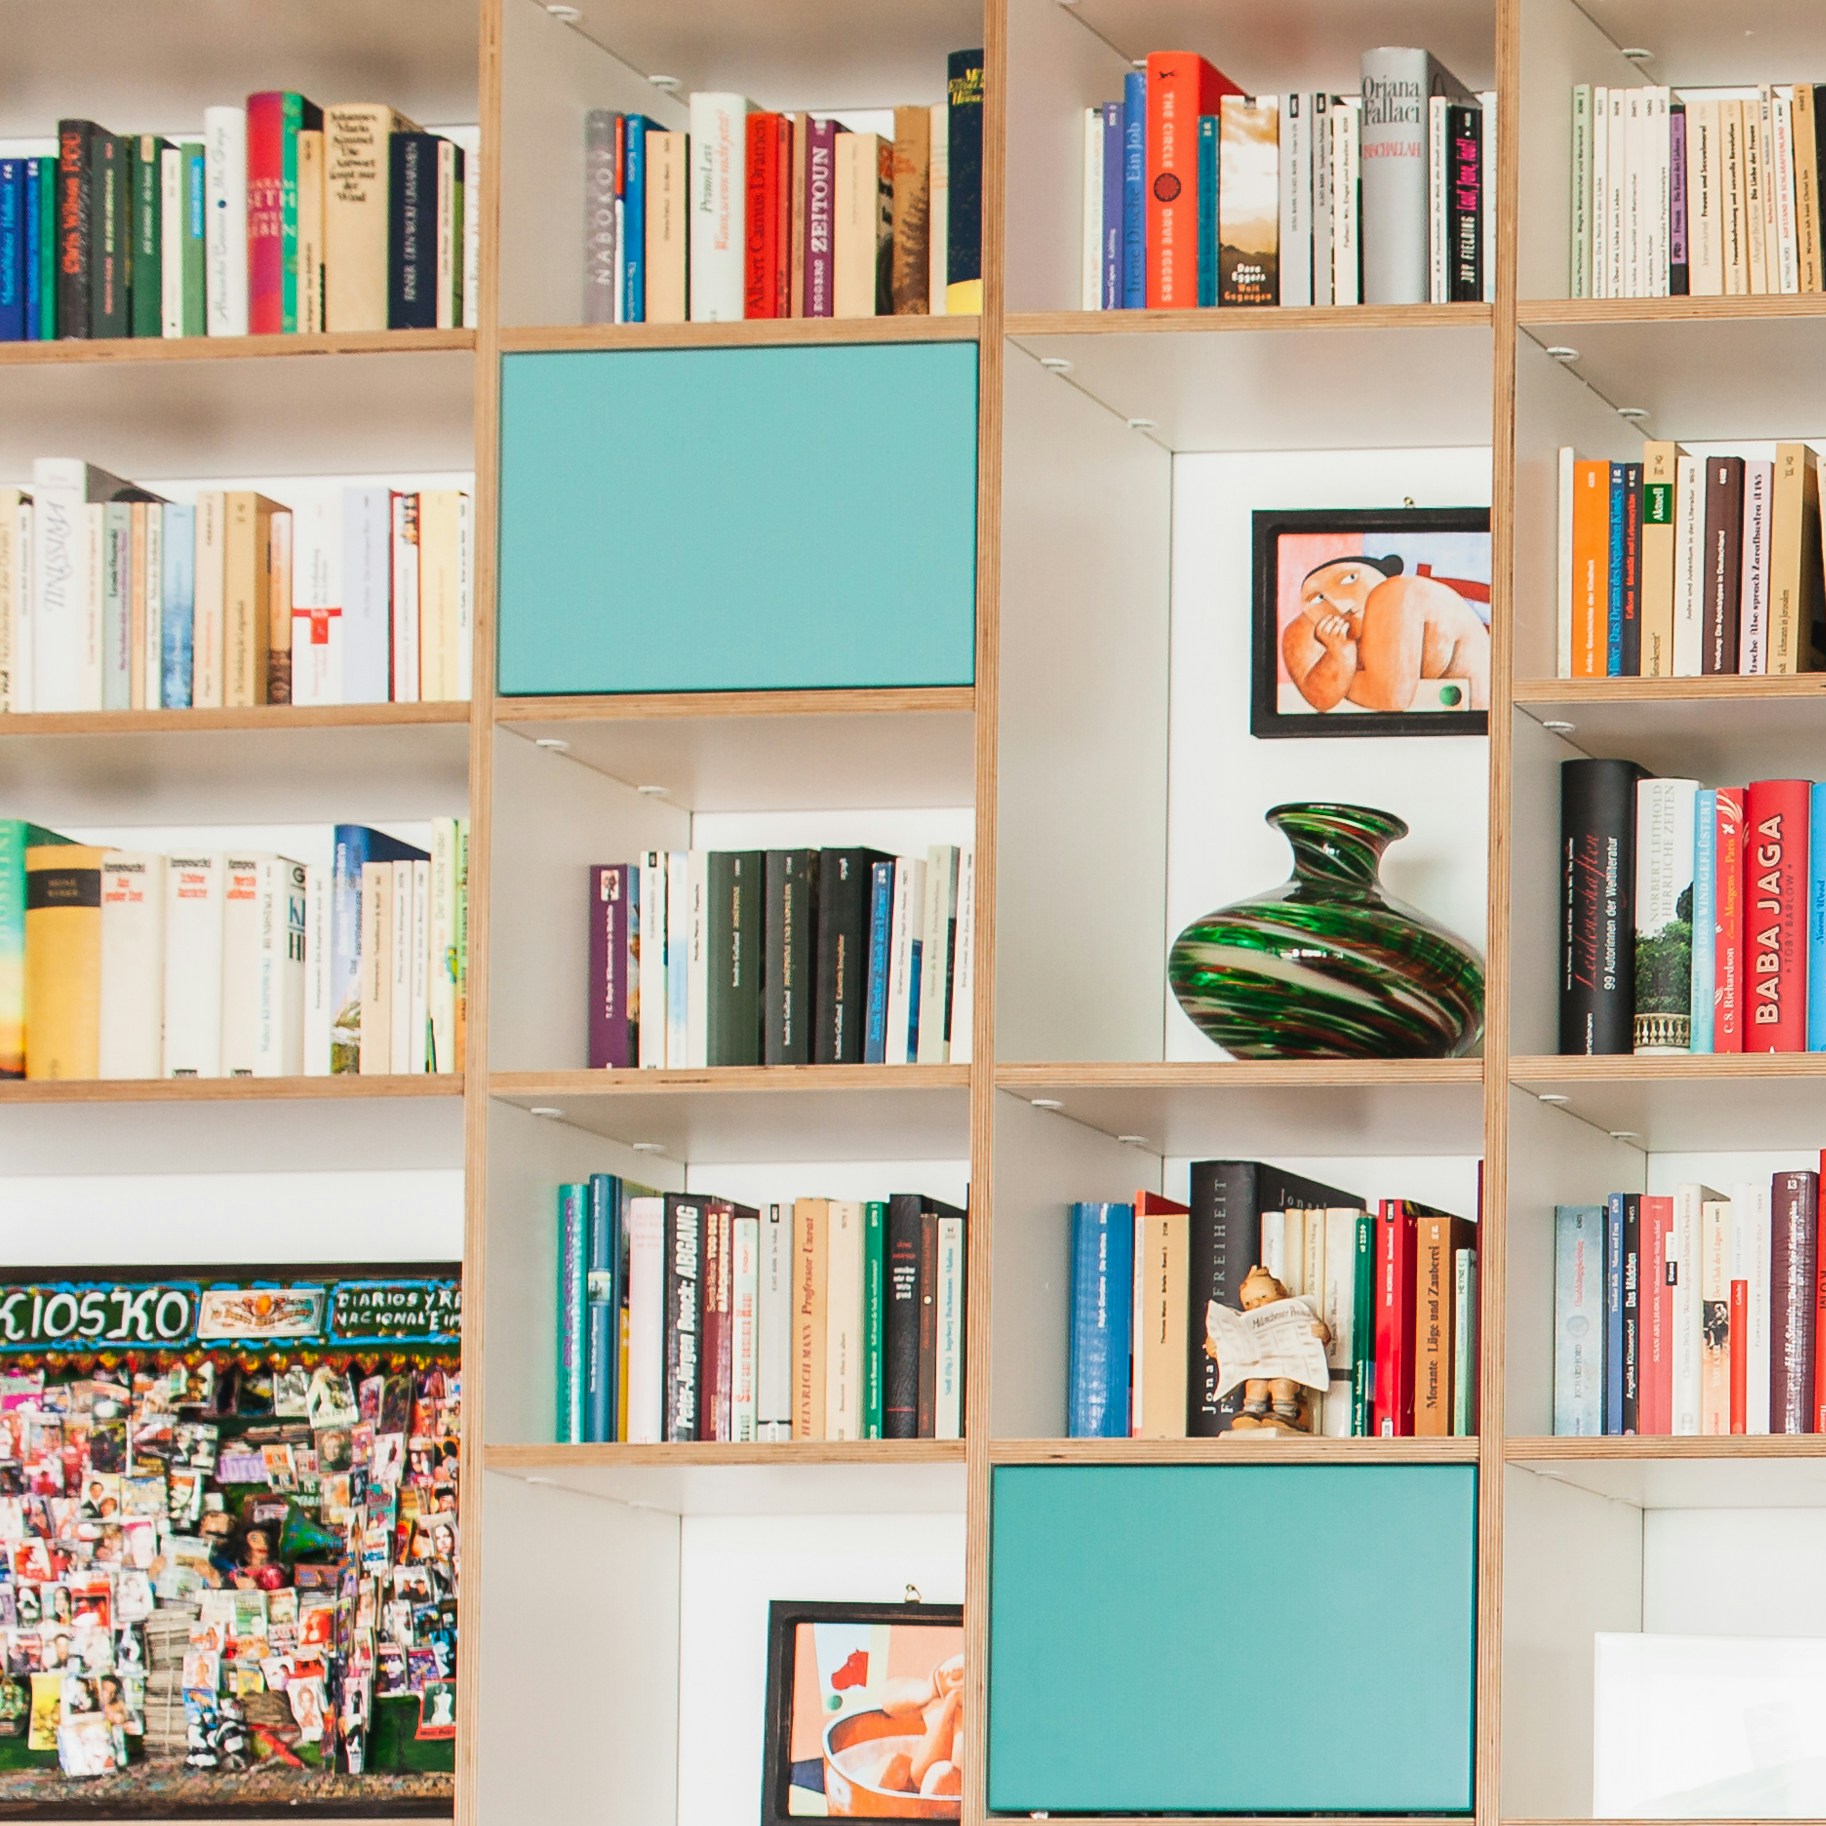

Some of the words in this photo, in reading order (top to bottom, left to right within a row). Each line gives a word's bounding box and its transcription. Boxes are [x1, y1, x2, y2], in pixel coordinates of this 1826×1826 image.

[1126, 122, 1142, 151] Job
[1126, 154, 1141, 181] Ein
[598, 151, 612, 284] NABOKOV
[811, 146, 828, 252] ZEITOUN
[750, 255, 765, 310] Albert
[1756, 814, 1781, 914] JAGA
[1574, 835, 1608, 990] Leidenschaften
[1756, 925, 1780, 1025] BABA
[674, 1205, 698, 1278] ABGANG
[1212, 1179, 1225, 1295] FREIHEIT
[801, 1258, 815, 1315] Professor
[1426, 1246, 1440, 1296] Zauberei
[1425, 1322, 1441, 1352] Lüge
[1427, 1299, 1439, 1319] und
[801, 1324, 812, 1360] MANN
[676, 1334, 697, 1429] Peter-Jürgen
[800, 1365, 812, 1436] HEINRICH
[1426, 1360, 1439, 1408] Morante
